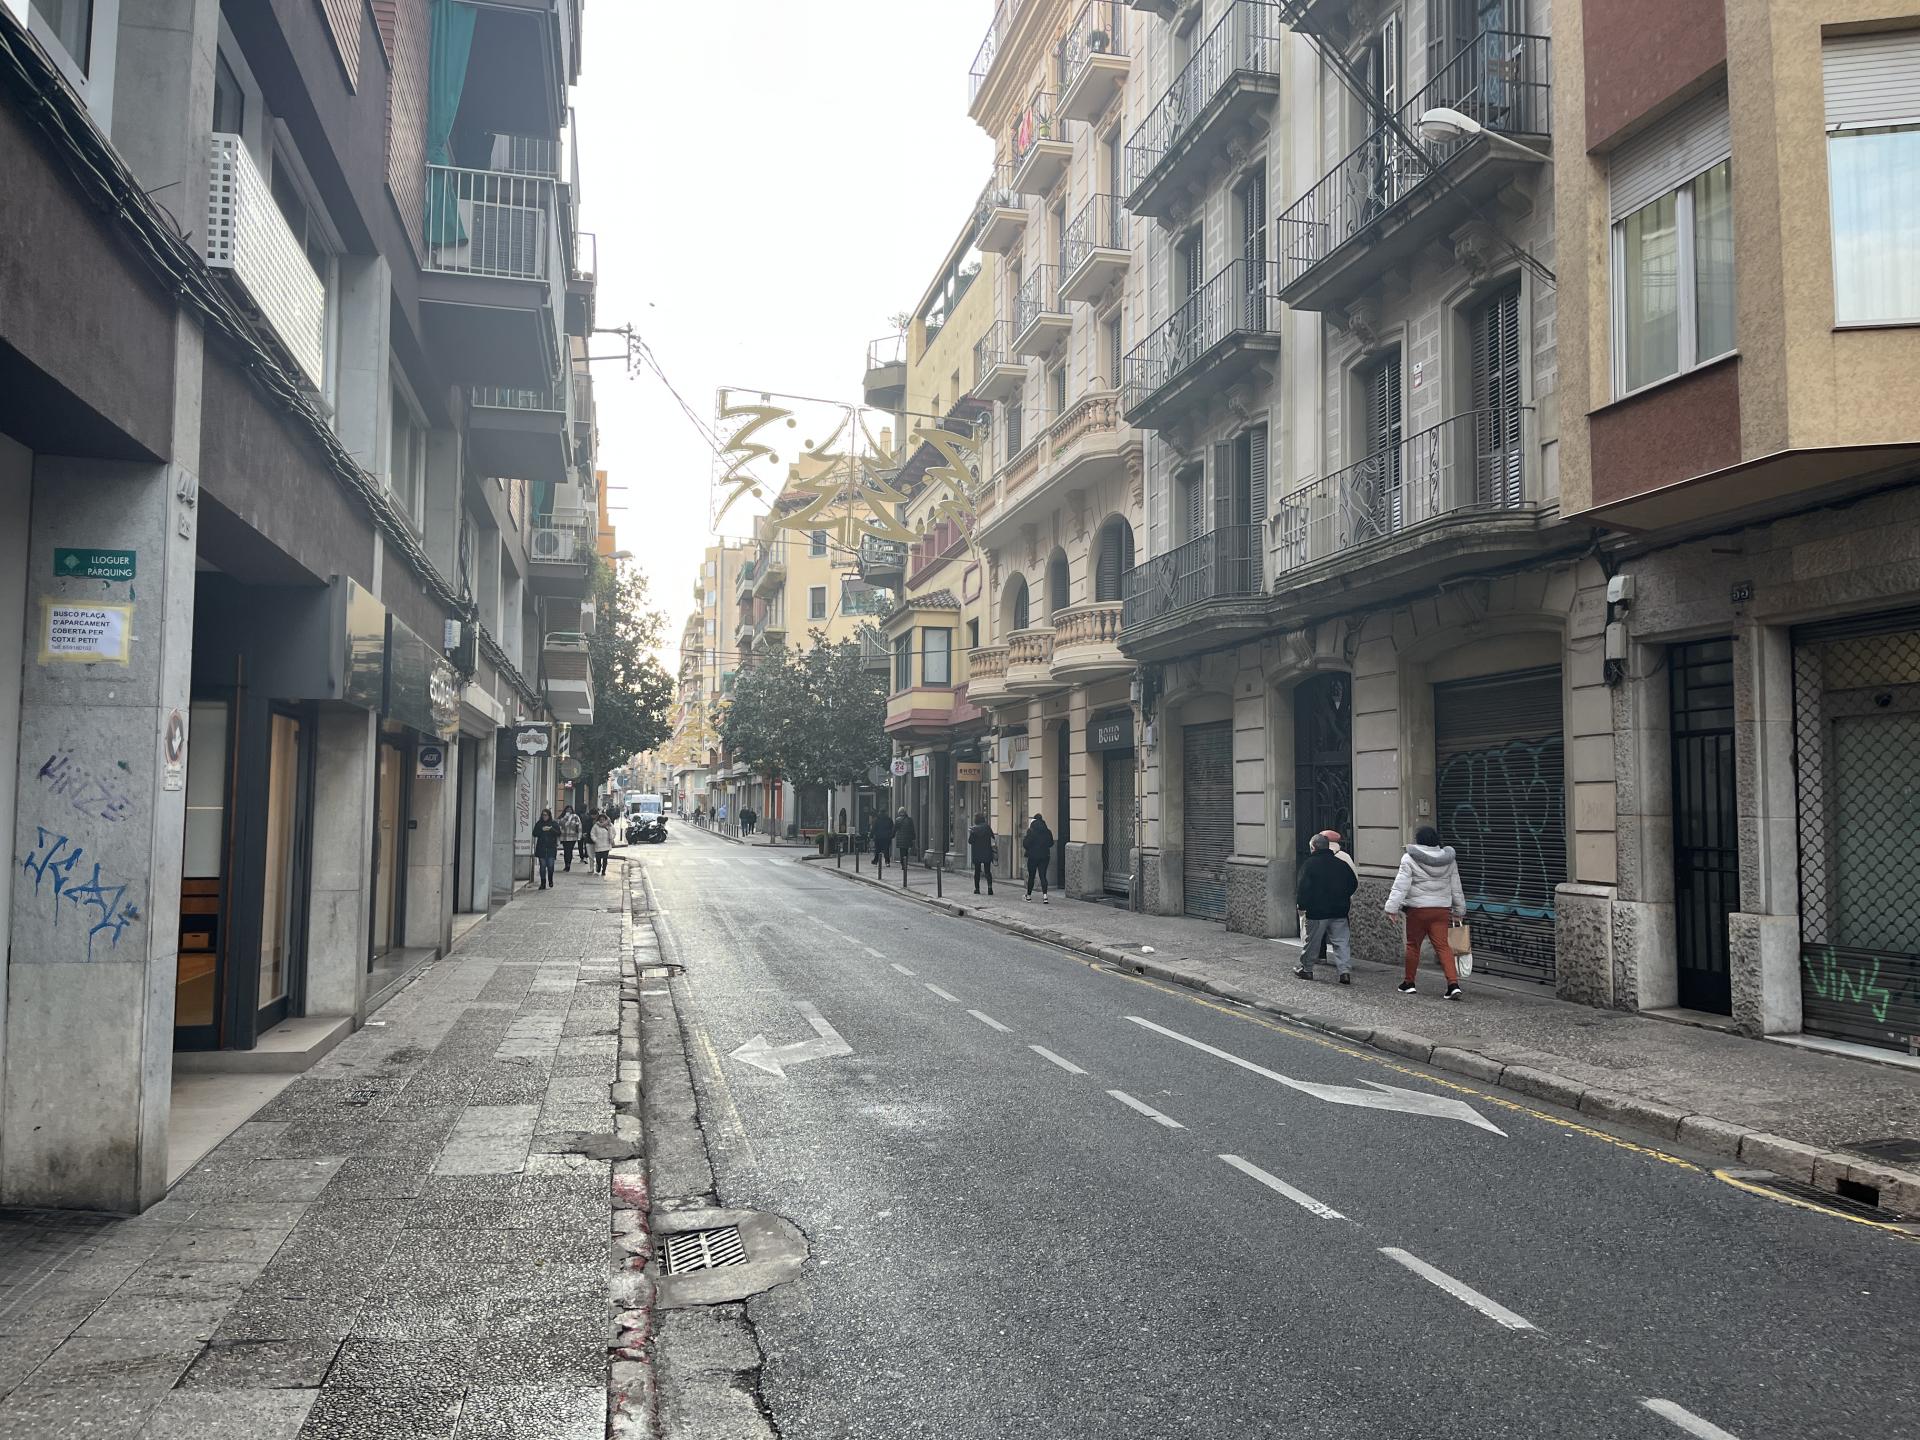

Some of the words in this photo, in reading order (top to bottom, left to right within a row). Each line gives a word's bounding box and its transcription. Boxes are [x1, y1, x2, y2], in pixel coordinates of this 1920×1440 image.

[91, 556, 130, 564] LLOGUER
[80, 611, 106, 619] PLAÇA
[1098, 725, 1120, 744] BOHO
